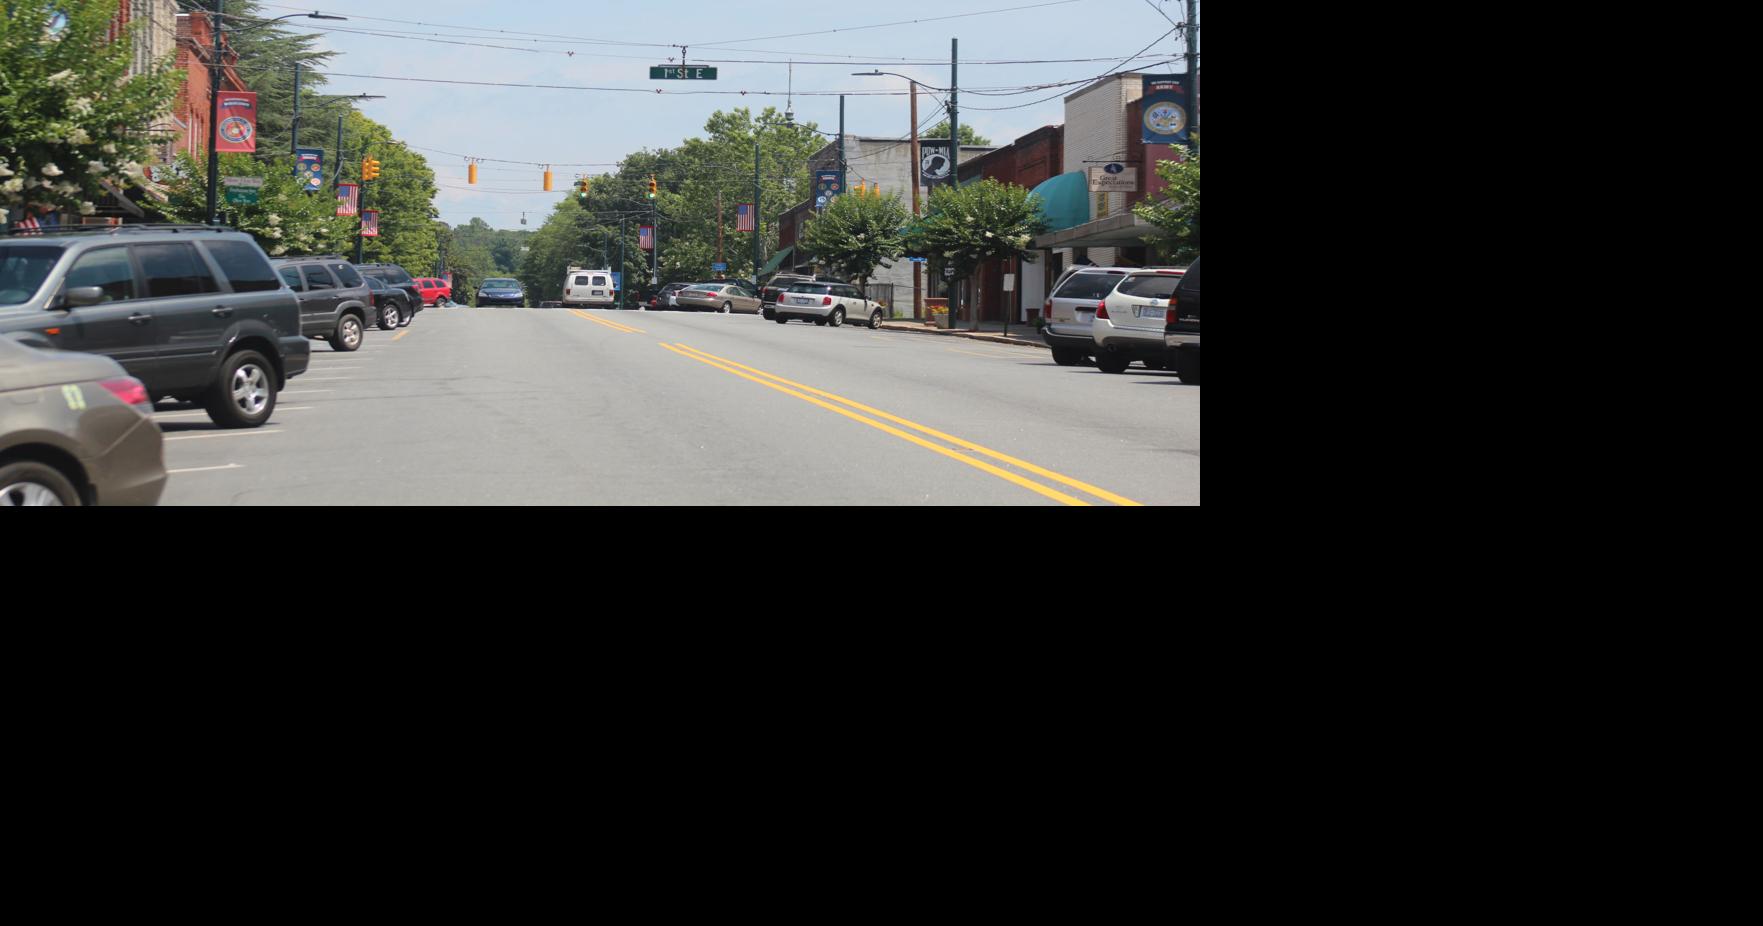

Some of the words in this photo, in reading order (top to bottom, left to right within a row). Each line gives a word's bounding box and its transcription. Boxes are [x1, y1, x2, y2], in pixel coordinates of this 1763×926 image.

[664, 68, 676, 79] 1st
[676, 68, 689, 79] St
[696, 68, 703, 79] E
